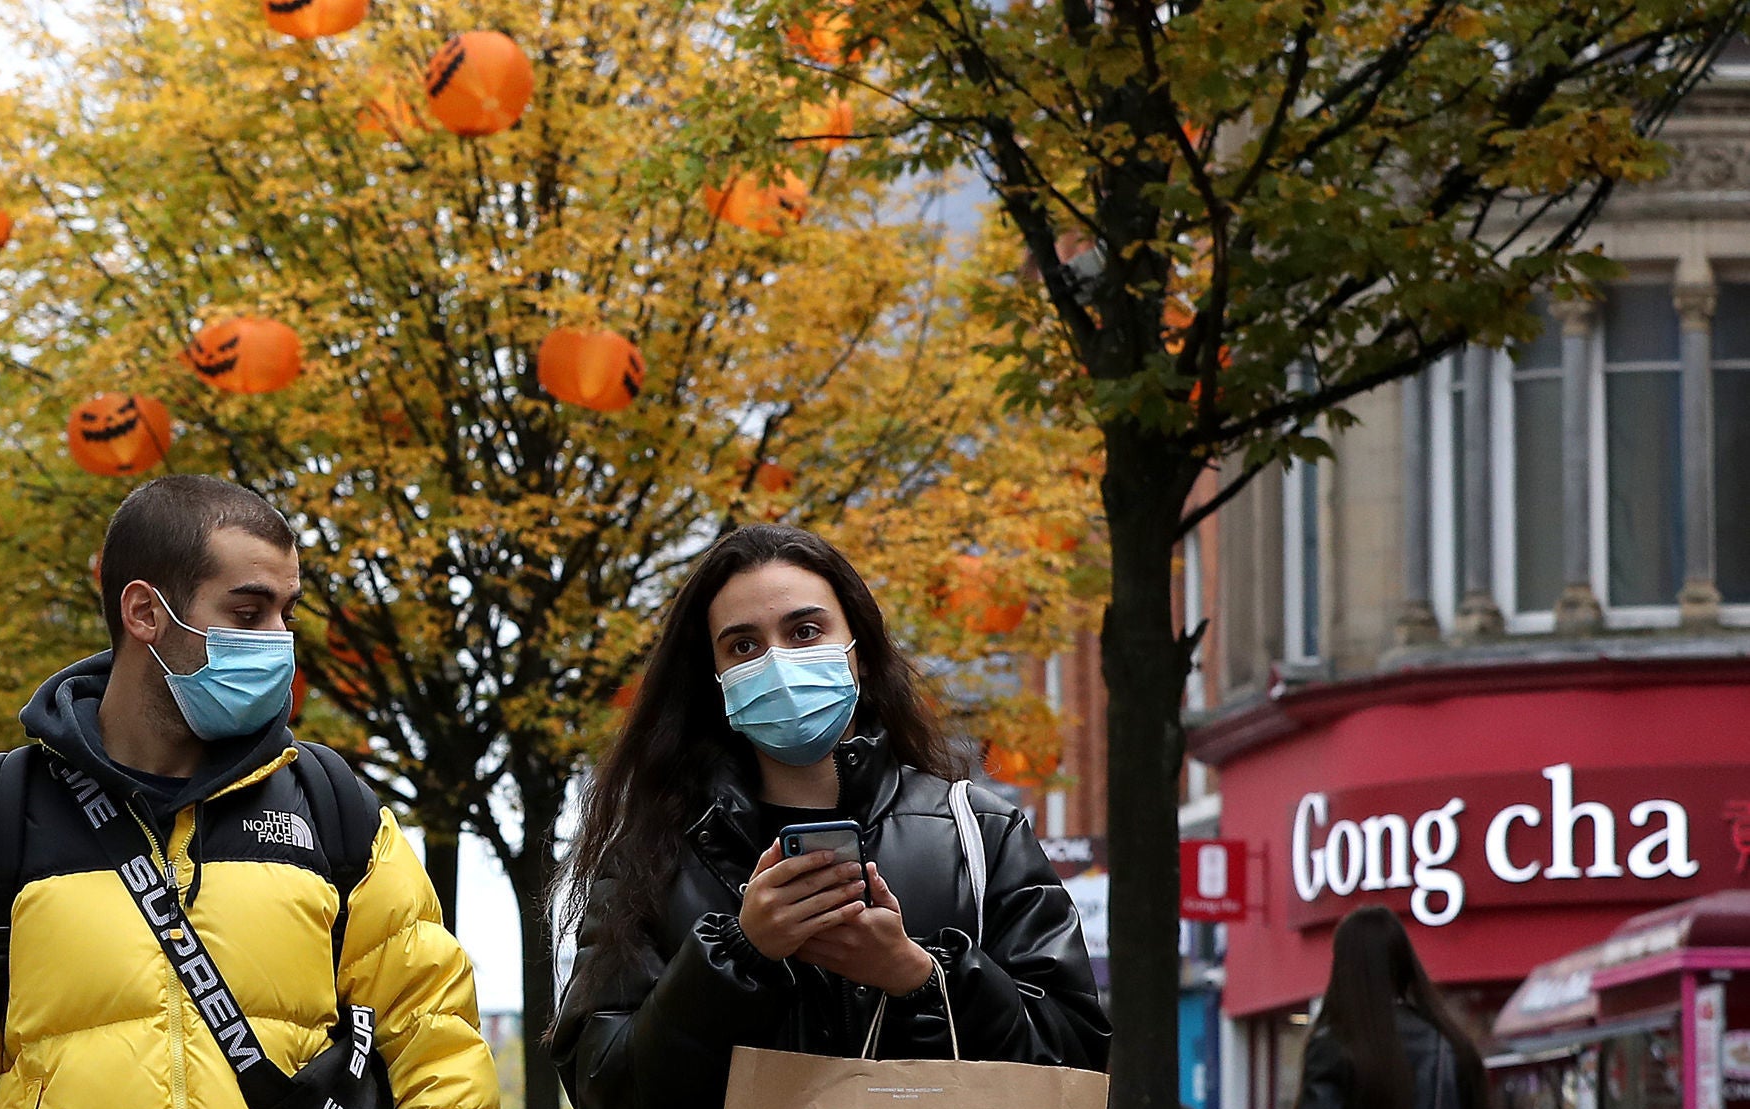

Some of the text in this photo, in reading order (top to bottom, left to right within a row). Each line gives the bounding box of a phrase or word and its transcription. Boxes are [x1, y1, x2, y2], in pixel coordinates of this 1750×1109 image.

[59, 767, 118, 829] ME
[262, 810, 291, 824] THE
[242, 819, 292, 837] NORTH
[257, 831, 293, 846] FACE
[1291, 792, 1465, 926] Gong
[1484, 762, 1700, 883] cha
[350, 1004, 374, 1080] SUP
